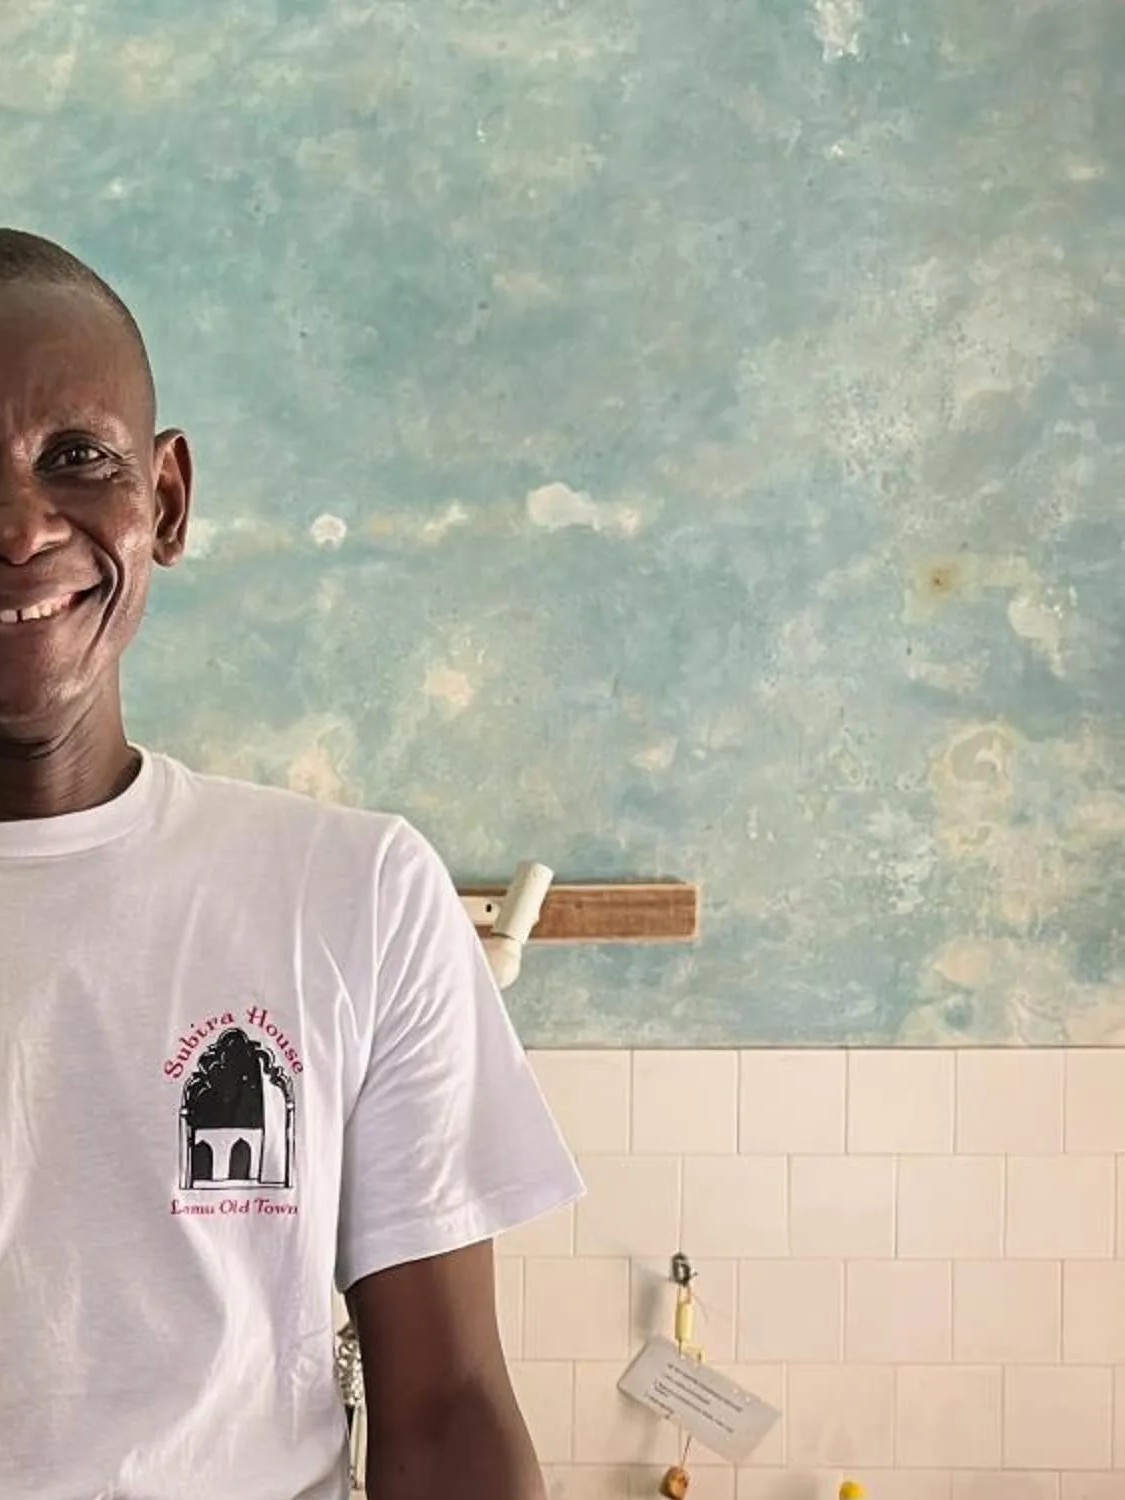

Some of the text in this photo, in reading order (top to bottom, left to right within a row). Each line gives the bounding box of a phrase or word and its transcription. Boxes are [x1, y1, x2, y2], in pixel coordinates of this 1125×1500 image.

[164, 1006, 304, 1079] Subira House
[170, 1197, 299, 1215] Lamu Old Town
